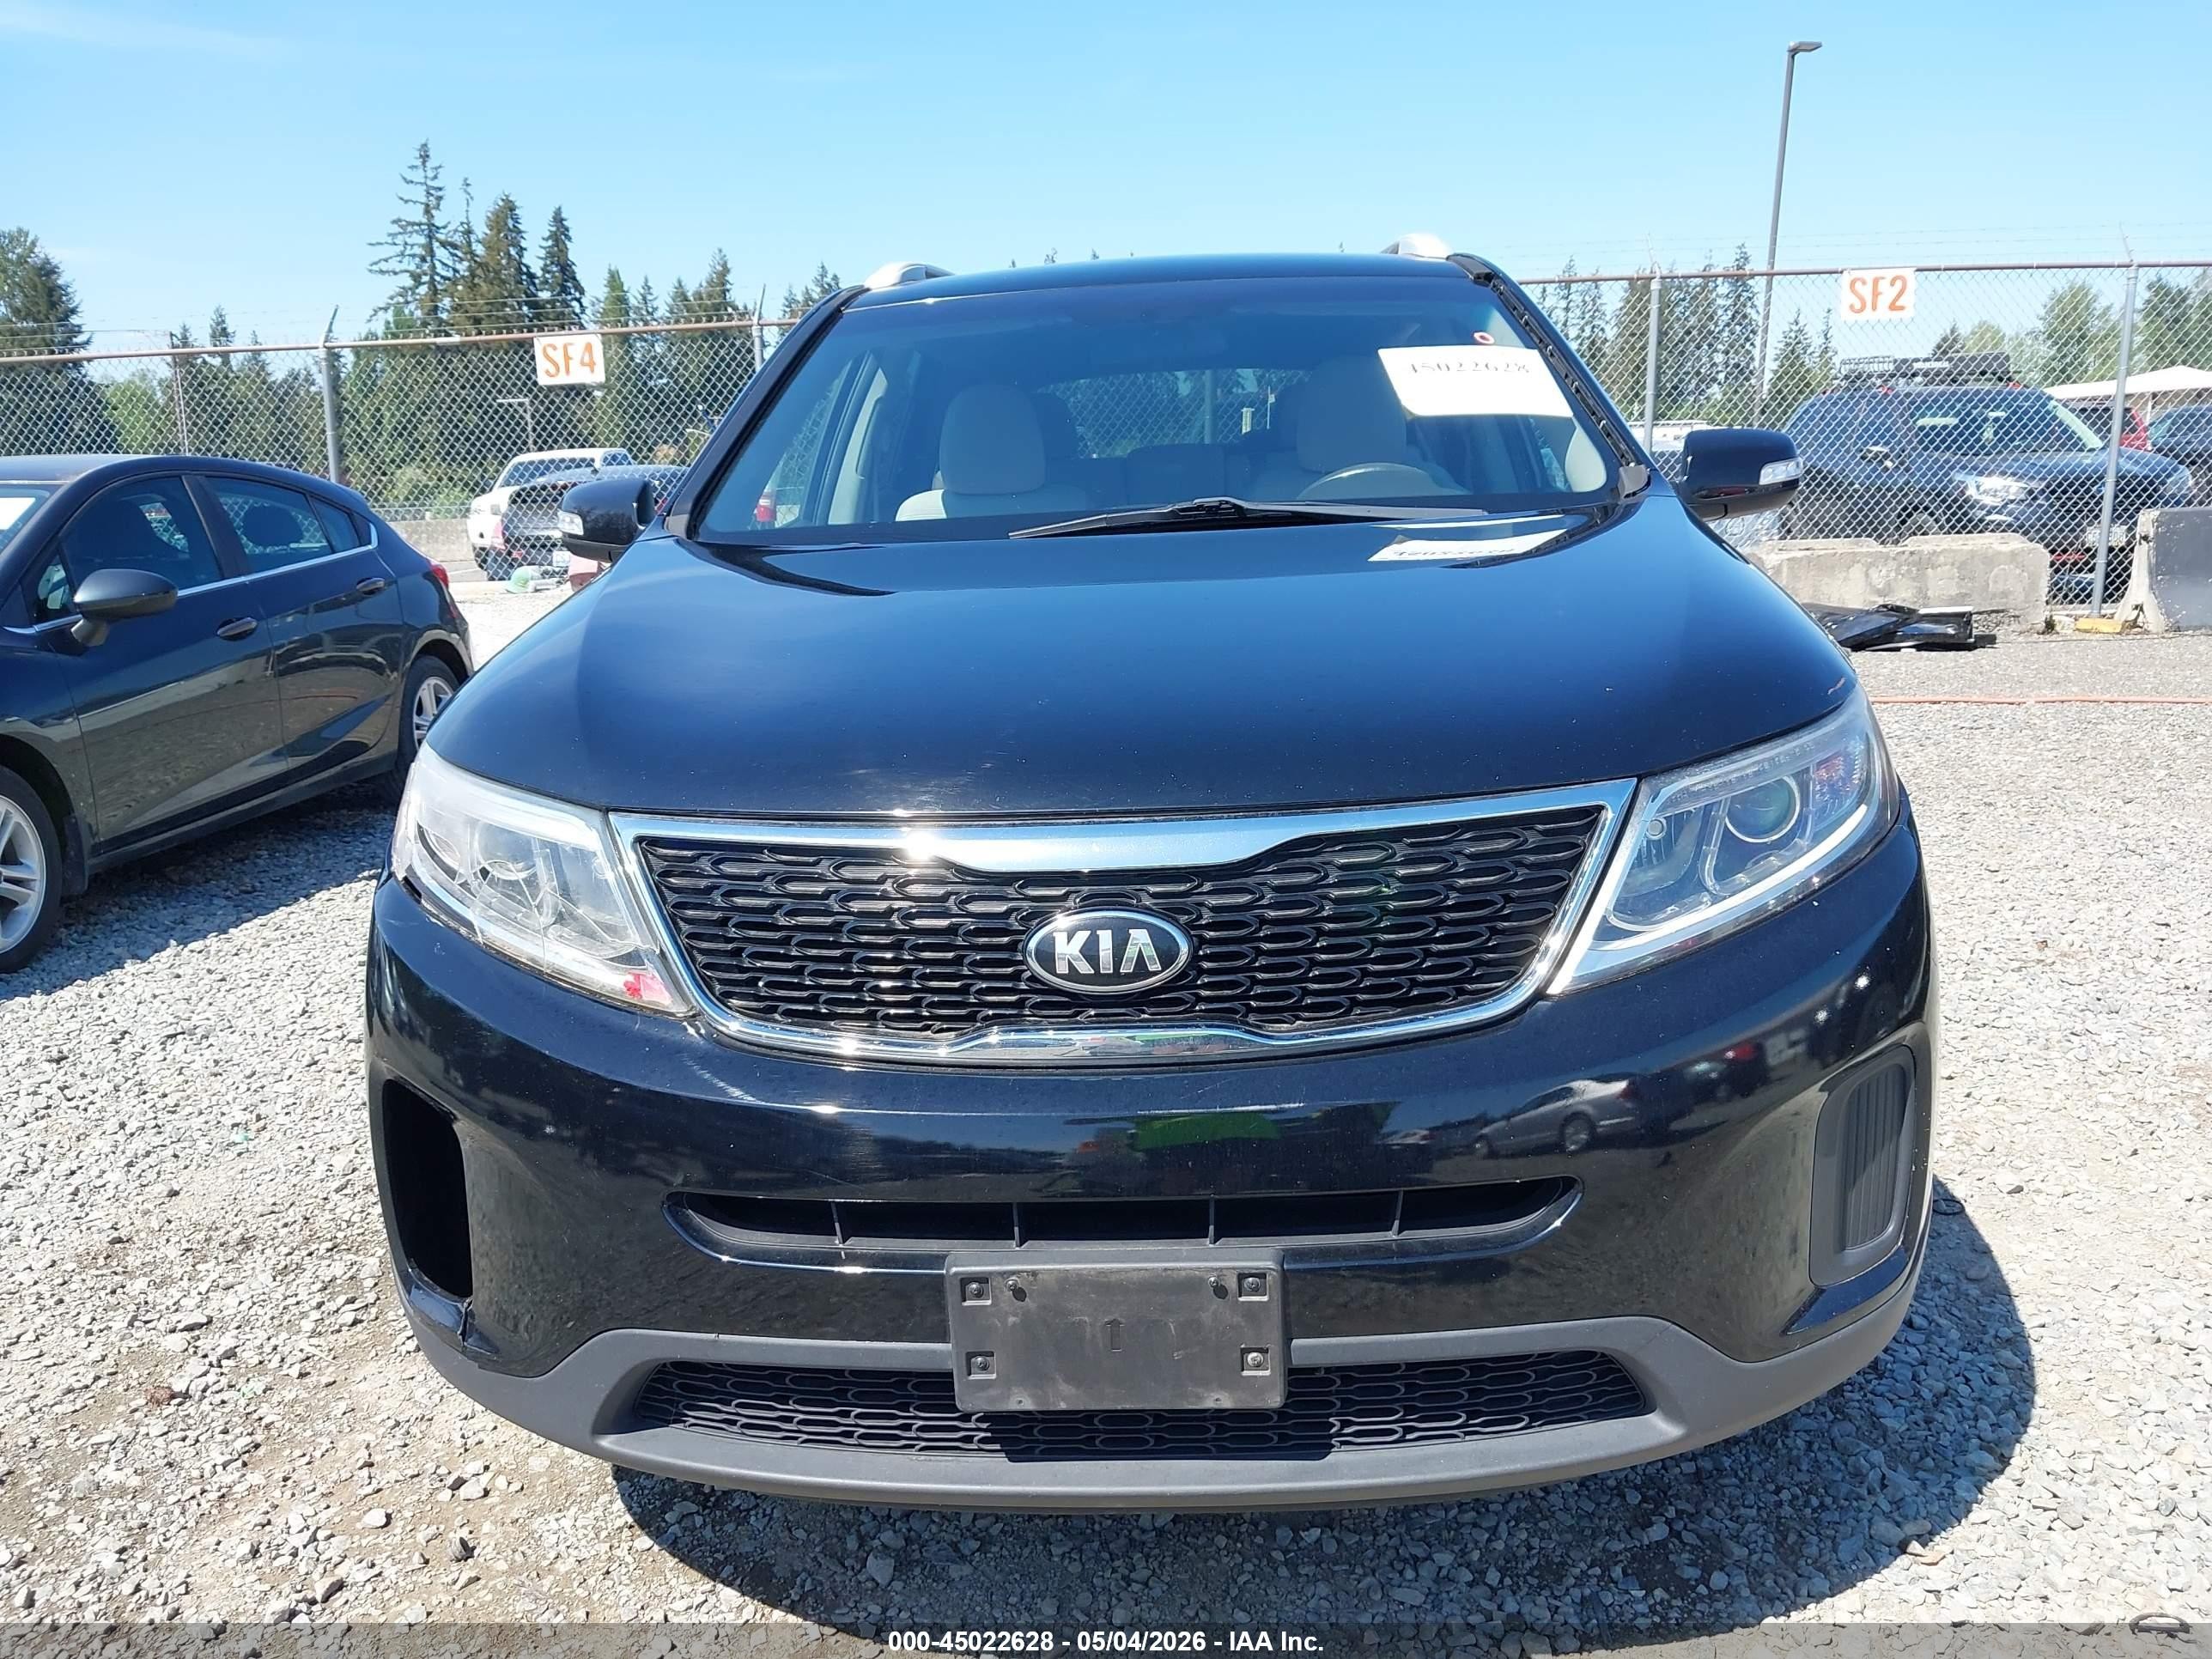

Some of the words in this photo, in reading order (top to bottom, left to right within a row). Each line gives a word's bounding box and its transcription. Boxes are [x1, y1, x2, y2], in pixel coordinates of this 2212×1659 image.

[1849, 275, 1907, 313] SF2
[543, 342, 596, 378] SF4
[1053, 928, 1162, 975] KIA
